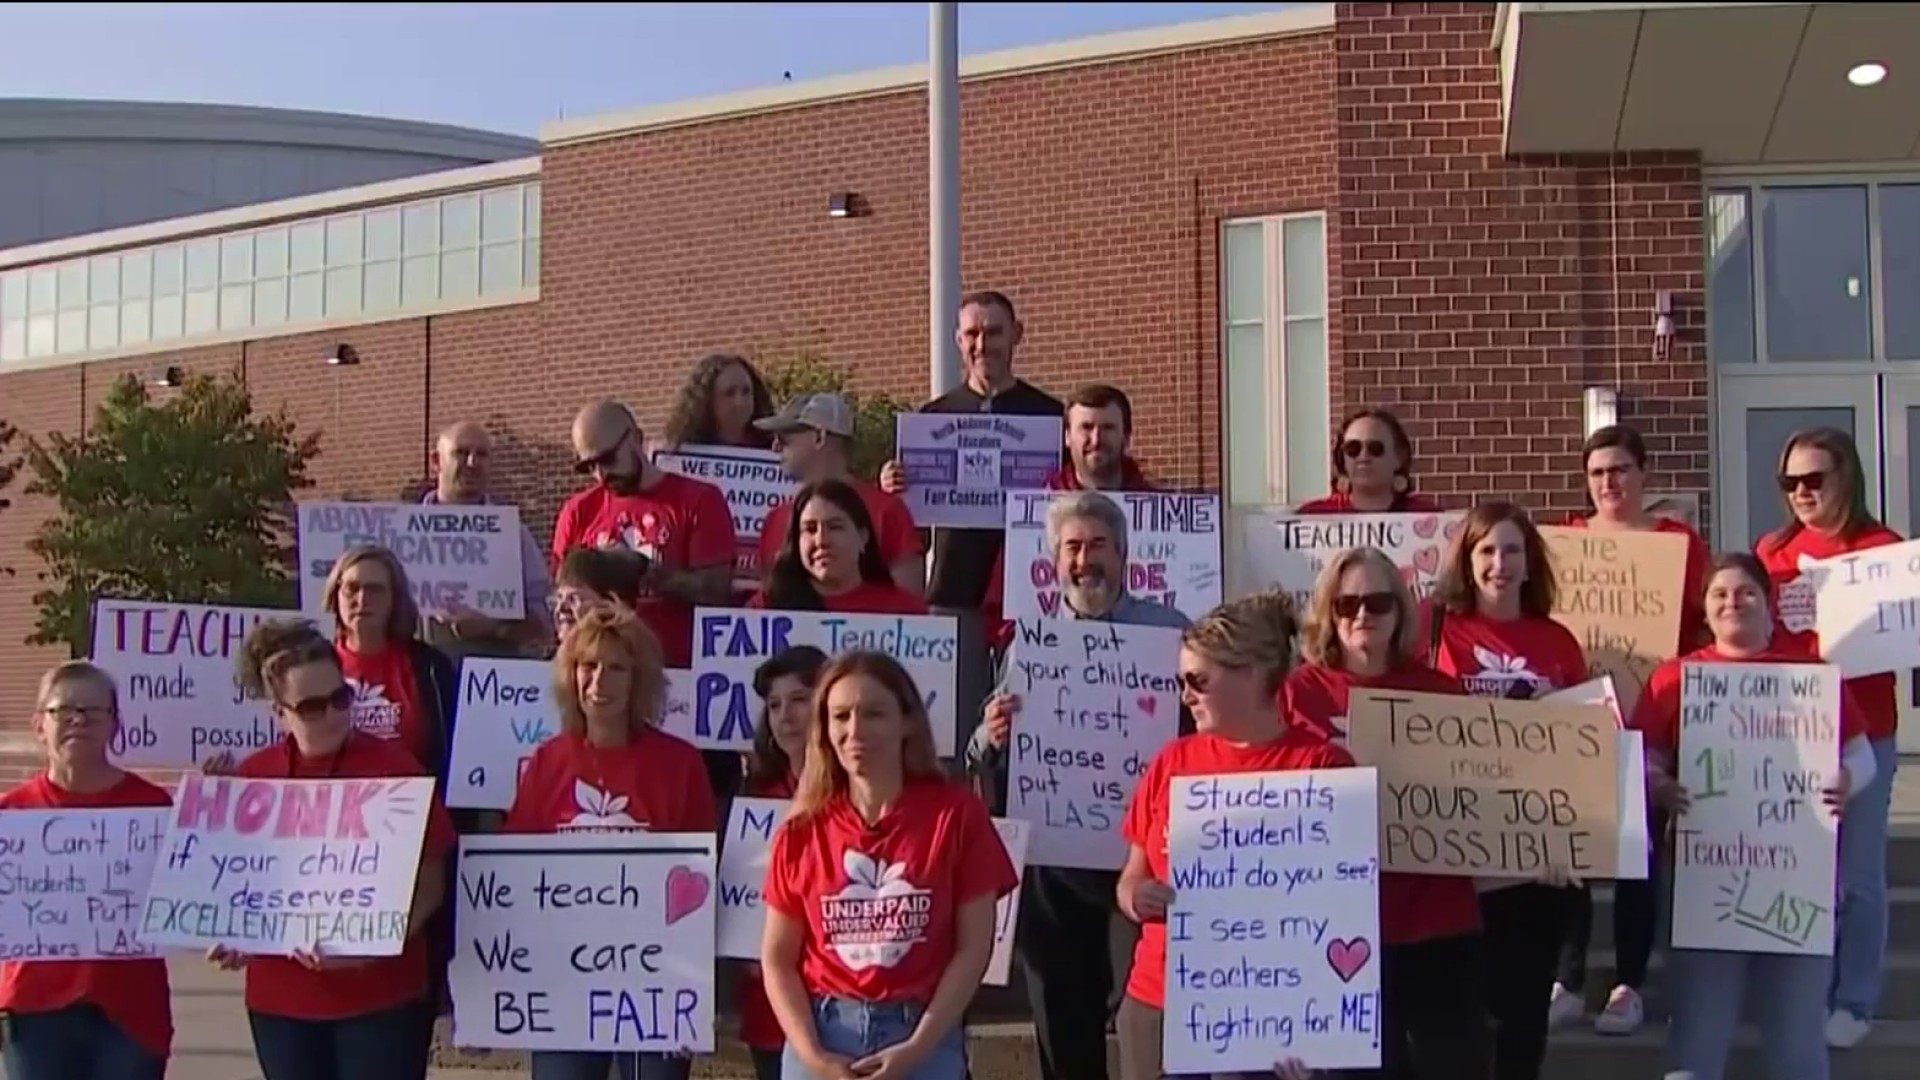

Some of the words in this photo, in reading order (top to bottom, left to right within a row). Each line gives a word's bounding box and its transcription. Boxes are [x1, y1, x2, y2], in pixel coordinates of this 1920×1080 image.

[681, 459, 710, 476] WE
[924, 488, 947, 506] Fair
[950, 489, 999, 506] Contract
[1124, 494, 1214, 533] TIME
[307, 506, 398, 535] ABOVE
[407, 513, 502, 533] AVERAGE
[1275, 519, 1405, 551] TEACHING
[476, 589, 517, 610] PAY
[1553, 587, 1665, 617] EACHERS
[701, 614, 794, 659] FAIR
[820, 617, 955, 663] Teachers
[1018, 617, 1059, 647] We
[1082, 624, 1126, 661] put
[130, 664, 197, 701] made
[467, 667, 541, 707] More
[1015, 660, 1072, 692] your
[1082, 661, 1178, 694] children
[1684, 665, 1729, 698] How
[1739, 672, 1780, 698] can
[1791, 673, 1822, 699] we
[1369, 695, 1602, 758] Teachers
[1683, 700, 1720, 730] put
[1729, 703, 1835, 743] Students
[1017, 732, 1107, 771] Please
[1450, 756, 1515, 780] made
[1017, 768, 1062, 808] put
[1092, 781, 1124, 801] us
[1753, 755, 1774, 792] if
[1781, 768, 1822, 795] we
[177, 777, 386, 840] HONK
[1387, 782, 1482, 822] YOUR
[1497, 787, 1579, 827] JOB
[1757, 796, 1804, 829] put
[42, 816, 110, 855] Can't
[128, 817, 164, 854] Put
[1386, 822, 1592, 872] POSSIBLE
[1678, 828, 1798, 870] Teachers
[0, 861, 87, 895] Students
[168, 832, 200, 870] if
[211, 851, 279, 892] your
[299, 841, 381, 877] child
[1172, 853, 1239, 890] What
[1245, 856, 1279, 888] do
[1283, 866, 1323, 895] you
[229, 879, 376, 910] deserves
[461, 869, 516, 911] We
[533, 862, 640, 911] teach
[1734, 867, 1829, 942] LAST
[22, 898, 68, 929] You
[86, 896, 140, 924] Put
[143, 896, 294, 943] EXCELLENT
[821, 896, 931, 919] UNDERPAID
[0, 932, 81, 957] eachers
[1171, 911, 1195, 941] I
[1210, 918, 1268, 942] see
[1279, 915, 1329, 946] my
[473, 929, 533, 973] We
[570, 943, 664, 973] care
[1175, 952, 1302, 990] teachers
[494, 990, 556, 1036] BE
[589, 986, 699, 1045] FAIR
[1185, 1002, 1293, 1054] fighting
[1302, 997, 1334, 1035] for
[1340, 986, 1381, 1049] ME!
